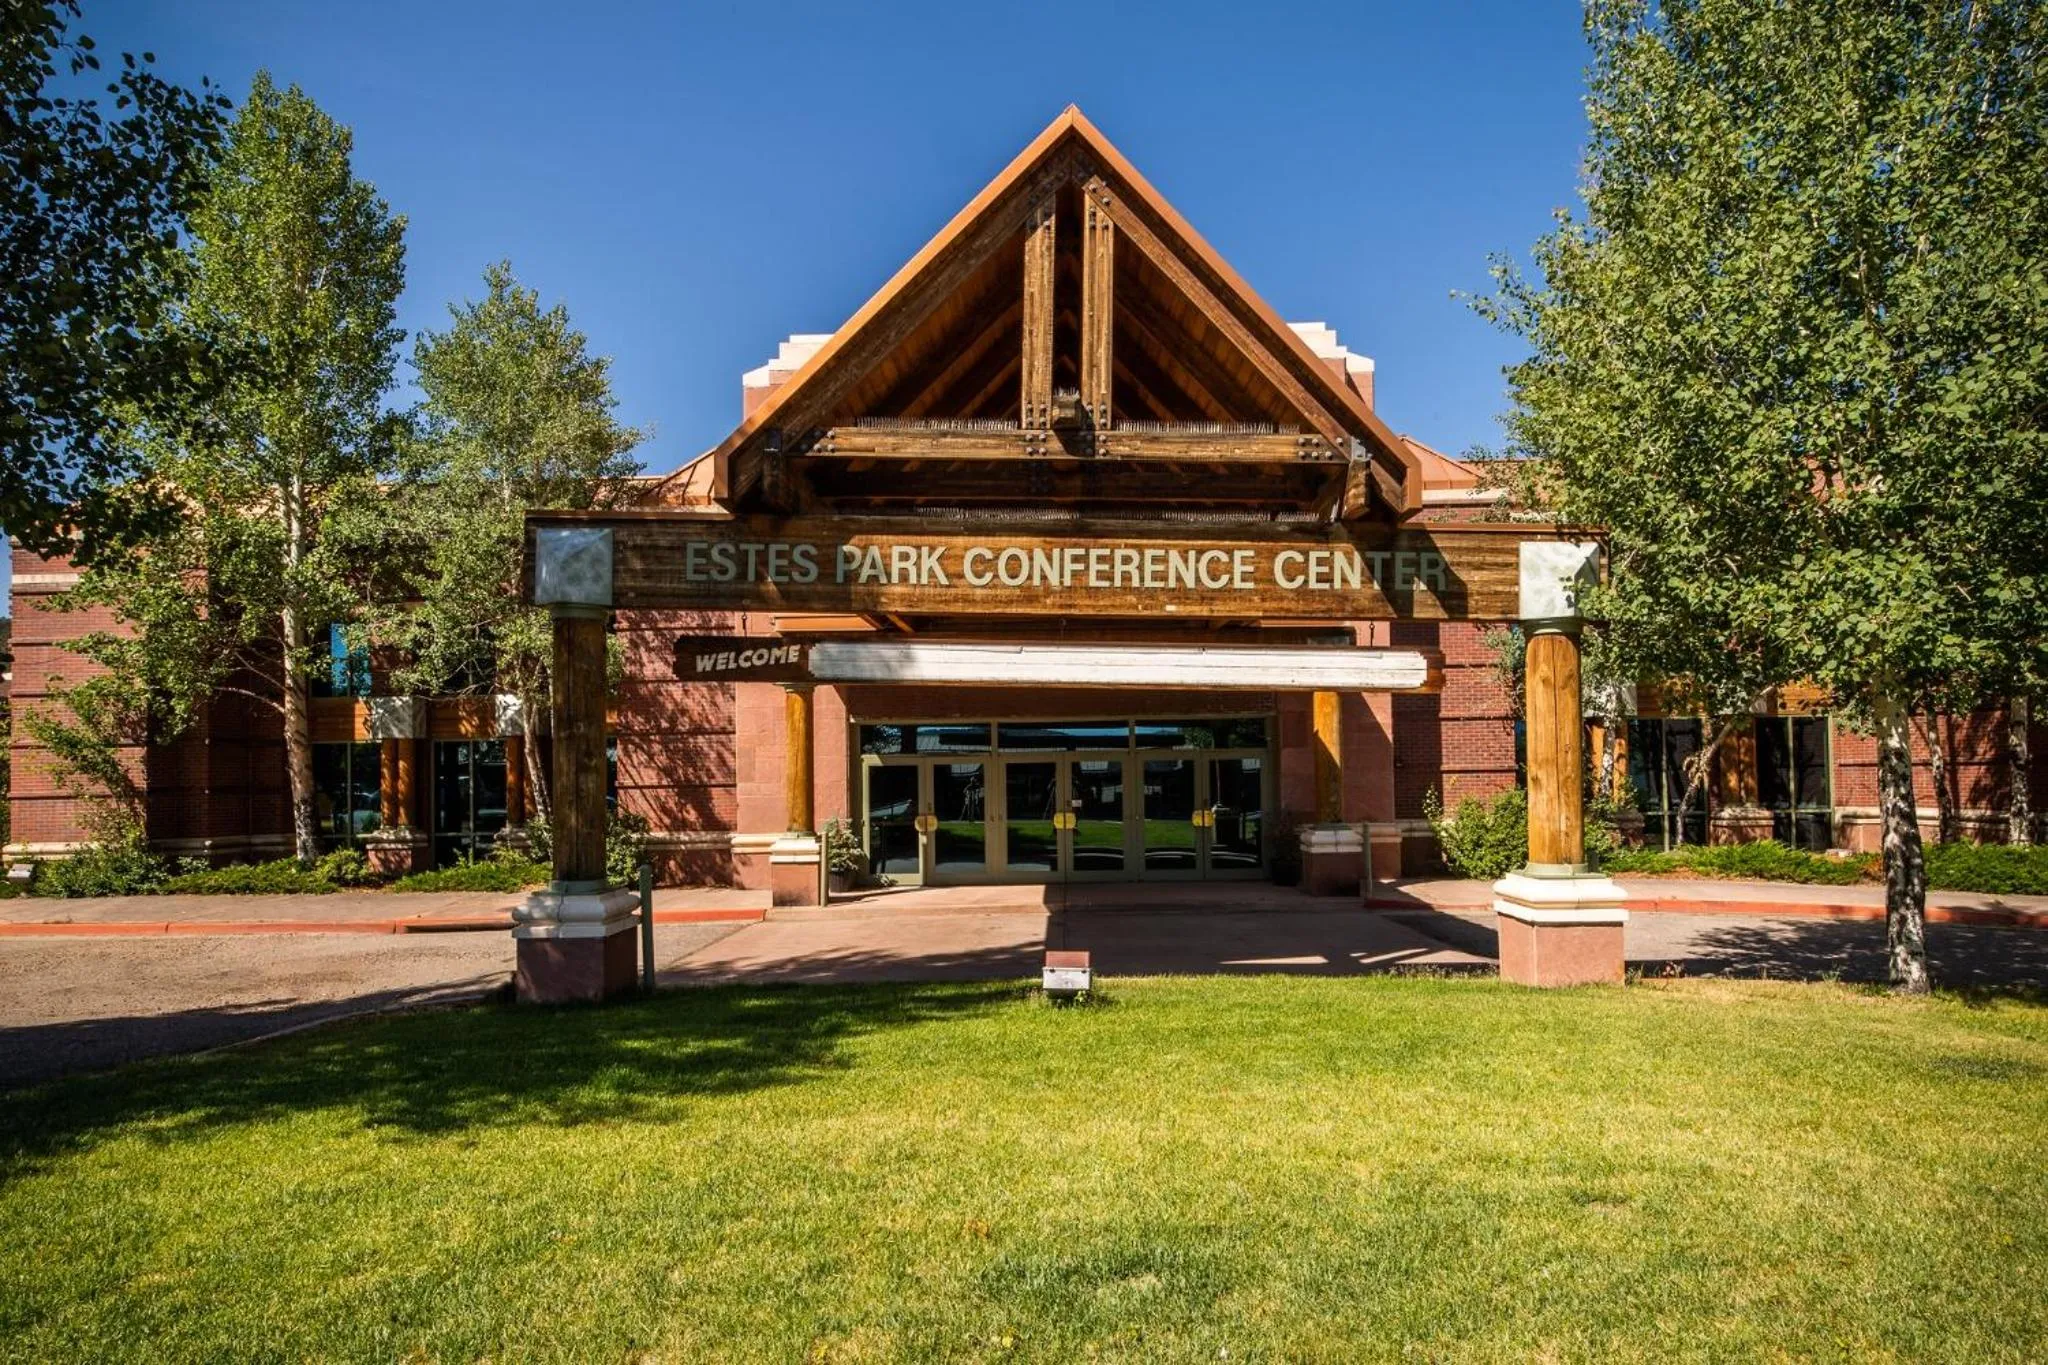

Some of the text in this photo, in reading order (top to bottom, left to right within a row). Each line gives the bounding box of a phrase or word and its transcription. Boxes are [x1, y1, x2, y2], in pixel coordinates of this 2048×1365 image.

[685, 542, 1448, 592] ESTES PARK CONFERENCE CENTER
[695, 644, 801, 672] WELCOME
